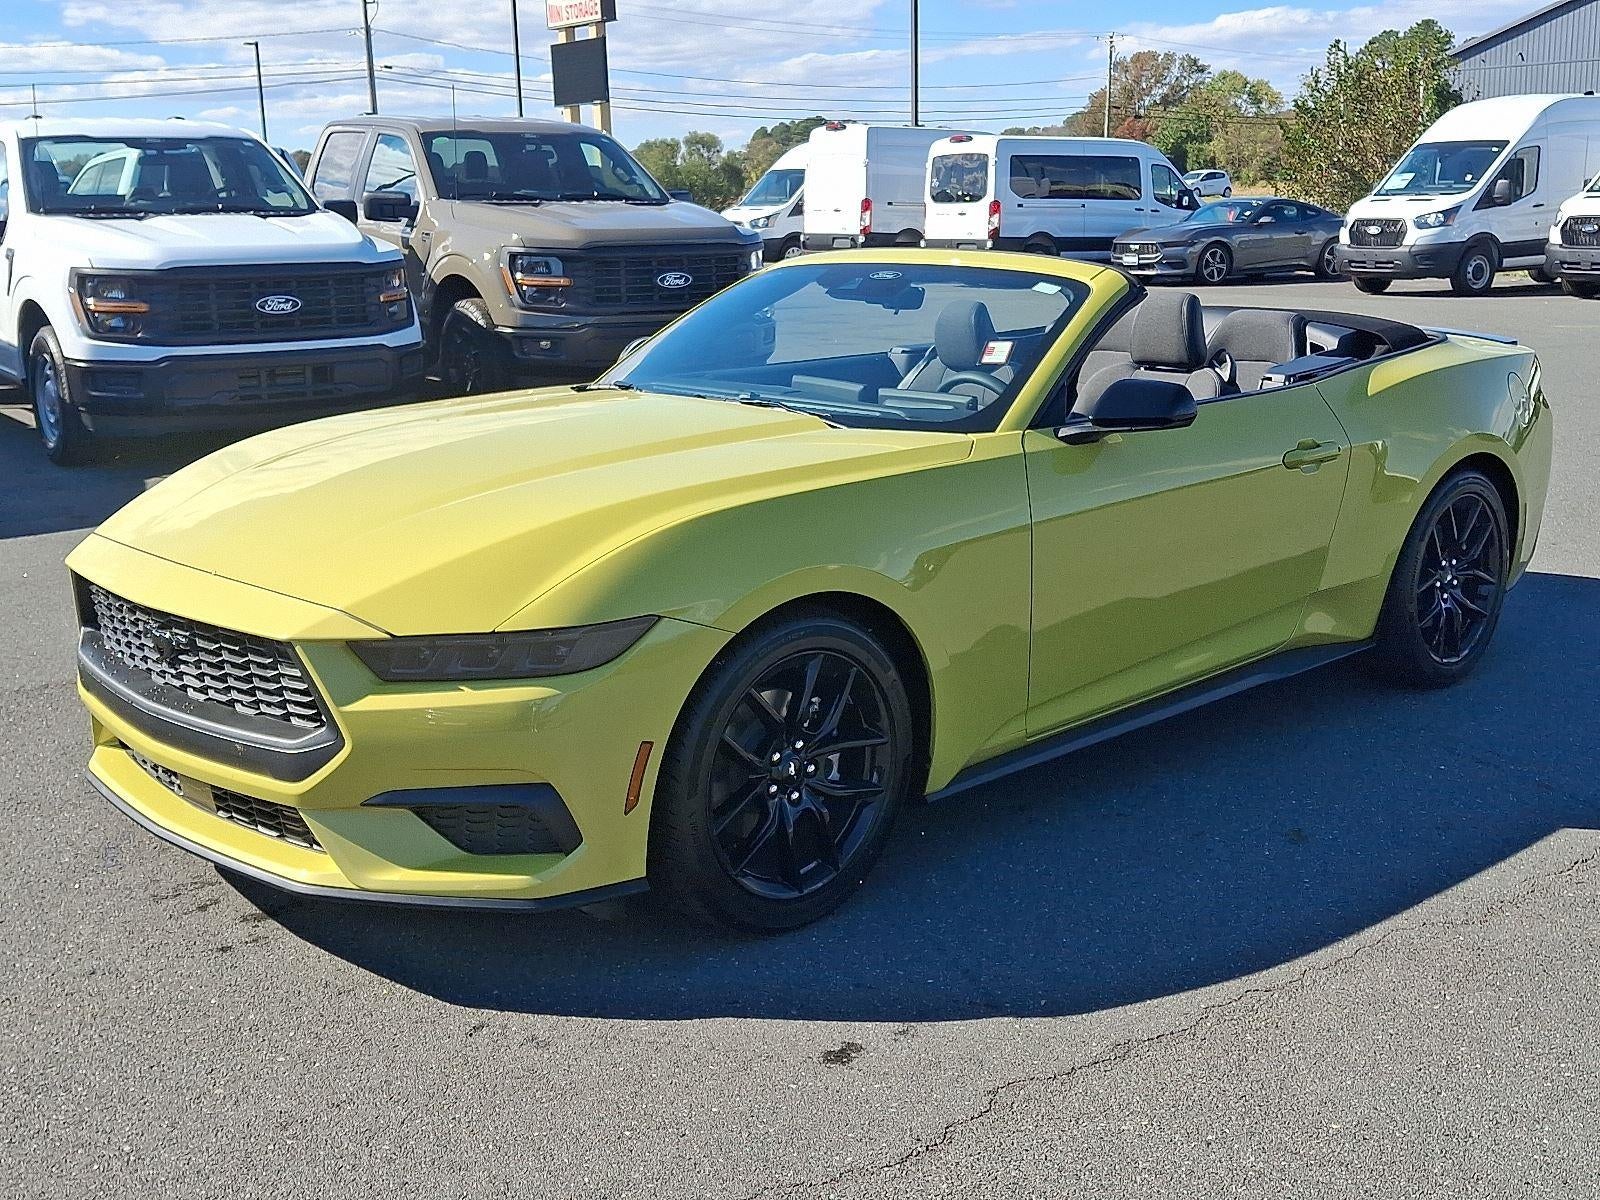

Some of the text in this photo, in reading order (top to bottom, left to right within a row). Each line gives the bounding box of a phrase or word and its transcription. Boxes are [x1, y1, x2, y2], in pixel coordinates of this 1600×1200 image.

[548, 0, 599, 23] MINI STORAGE
[663, 274, 686, 286] Ford
[264, 297, 293, 311] Ford
